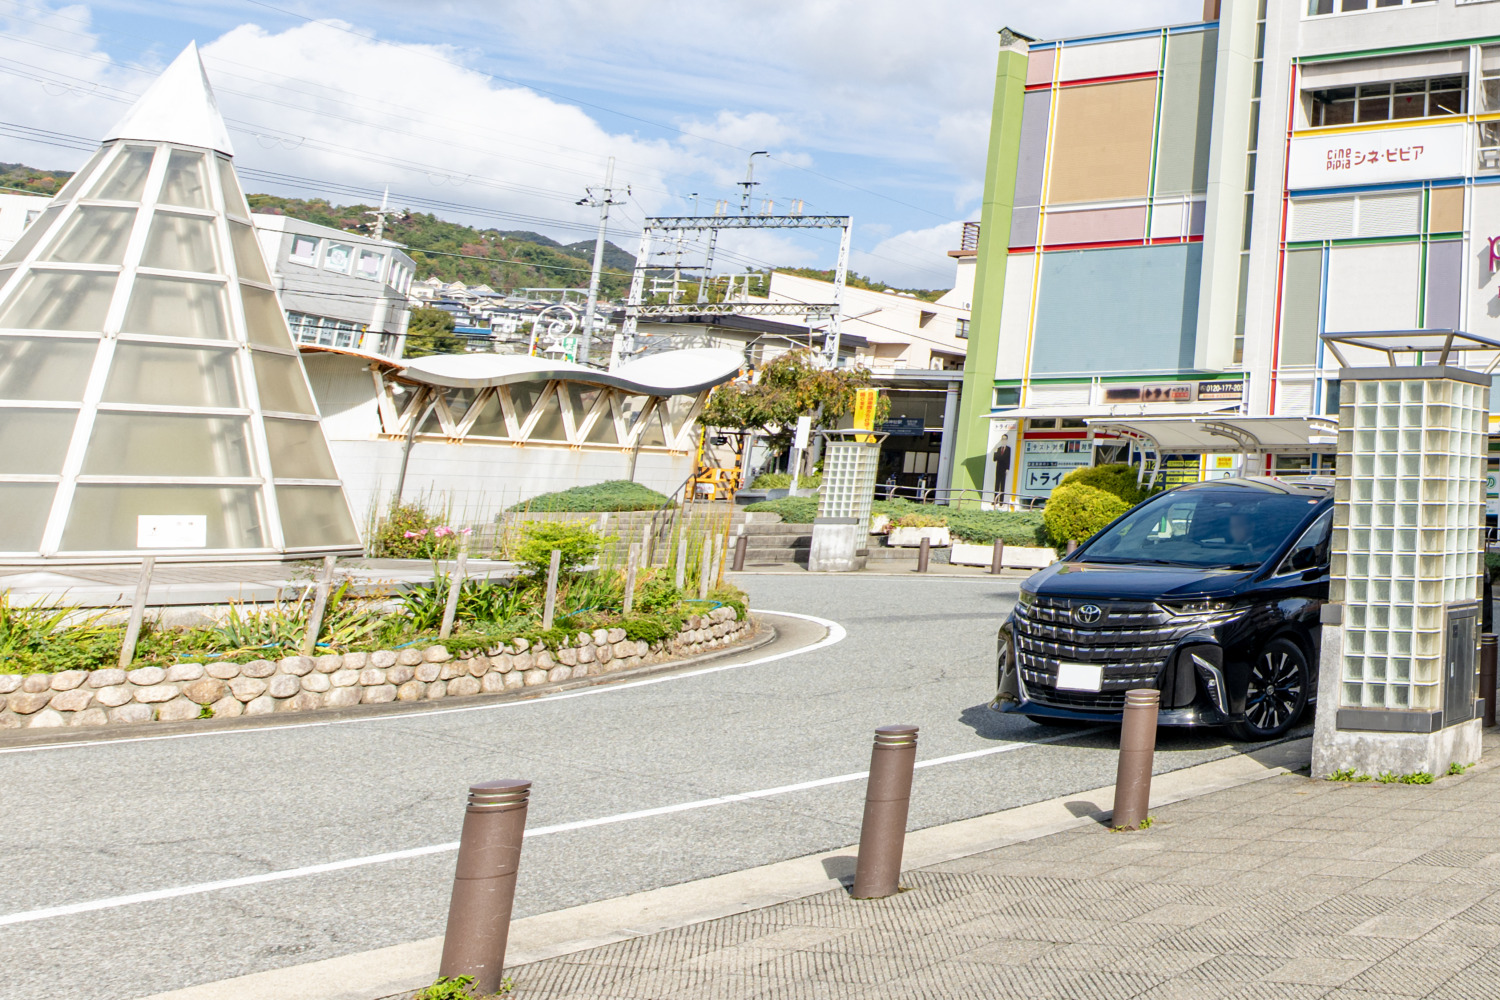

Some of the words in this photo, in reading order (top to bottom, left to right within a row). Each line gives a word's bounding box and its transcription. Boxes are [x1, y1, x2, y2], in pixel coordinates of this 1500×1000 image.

[1327, 148, 1352, 160] cine
[1326, 159, 1351, 171] pipia
[1030, 472, 1062, 486] トライ
